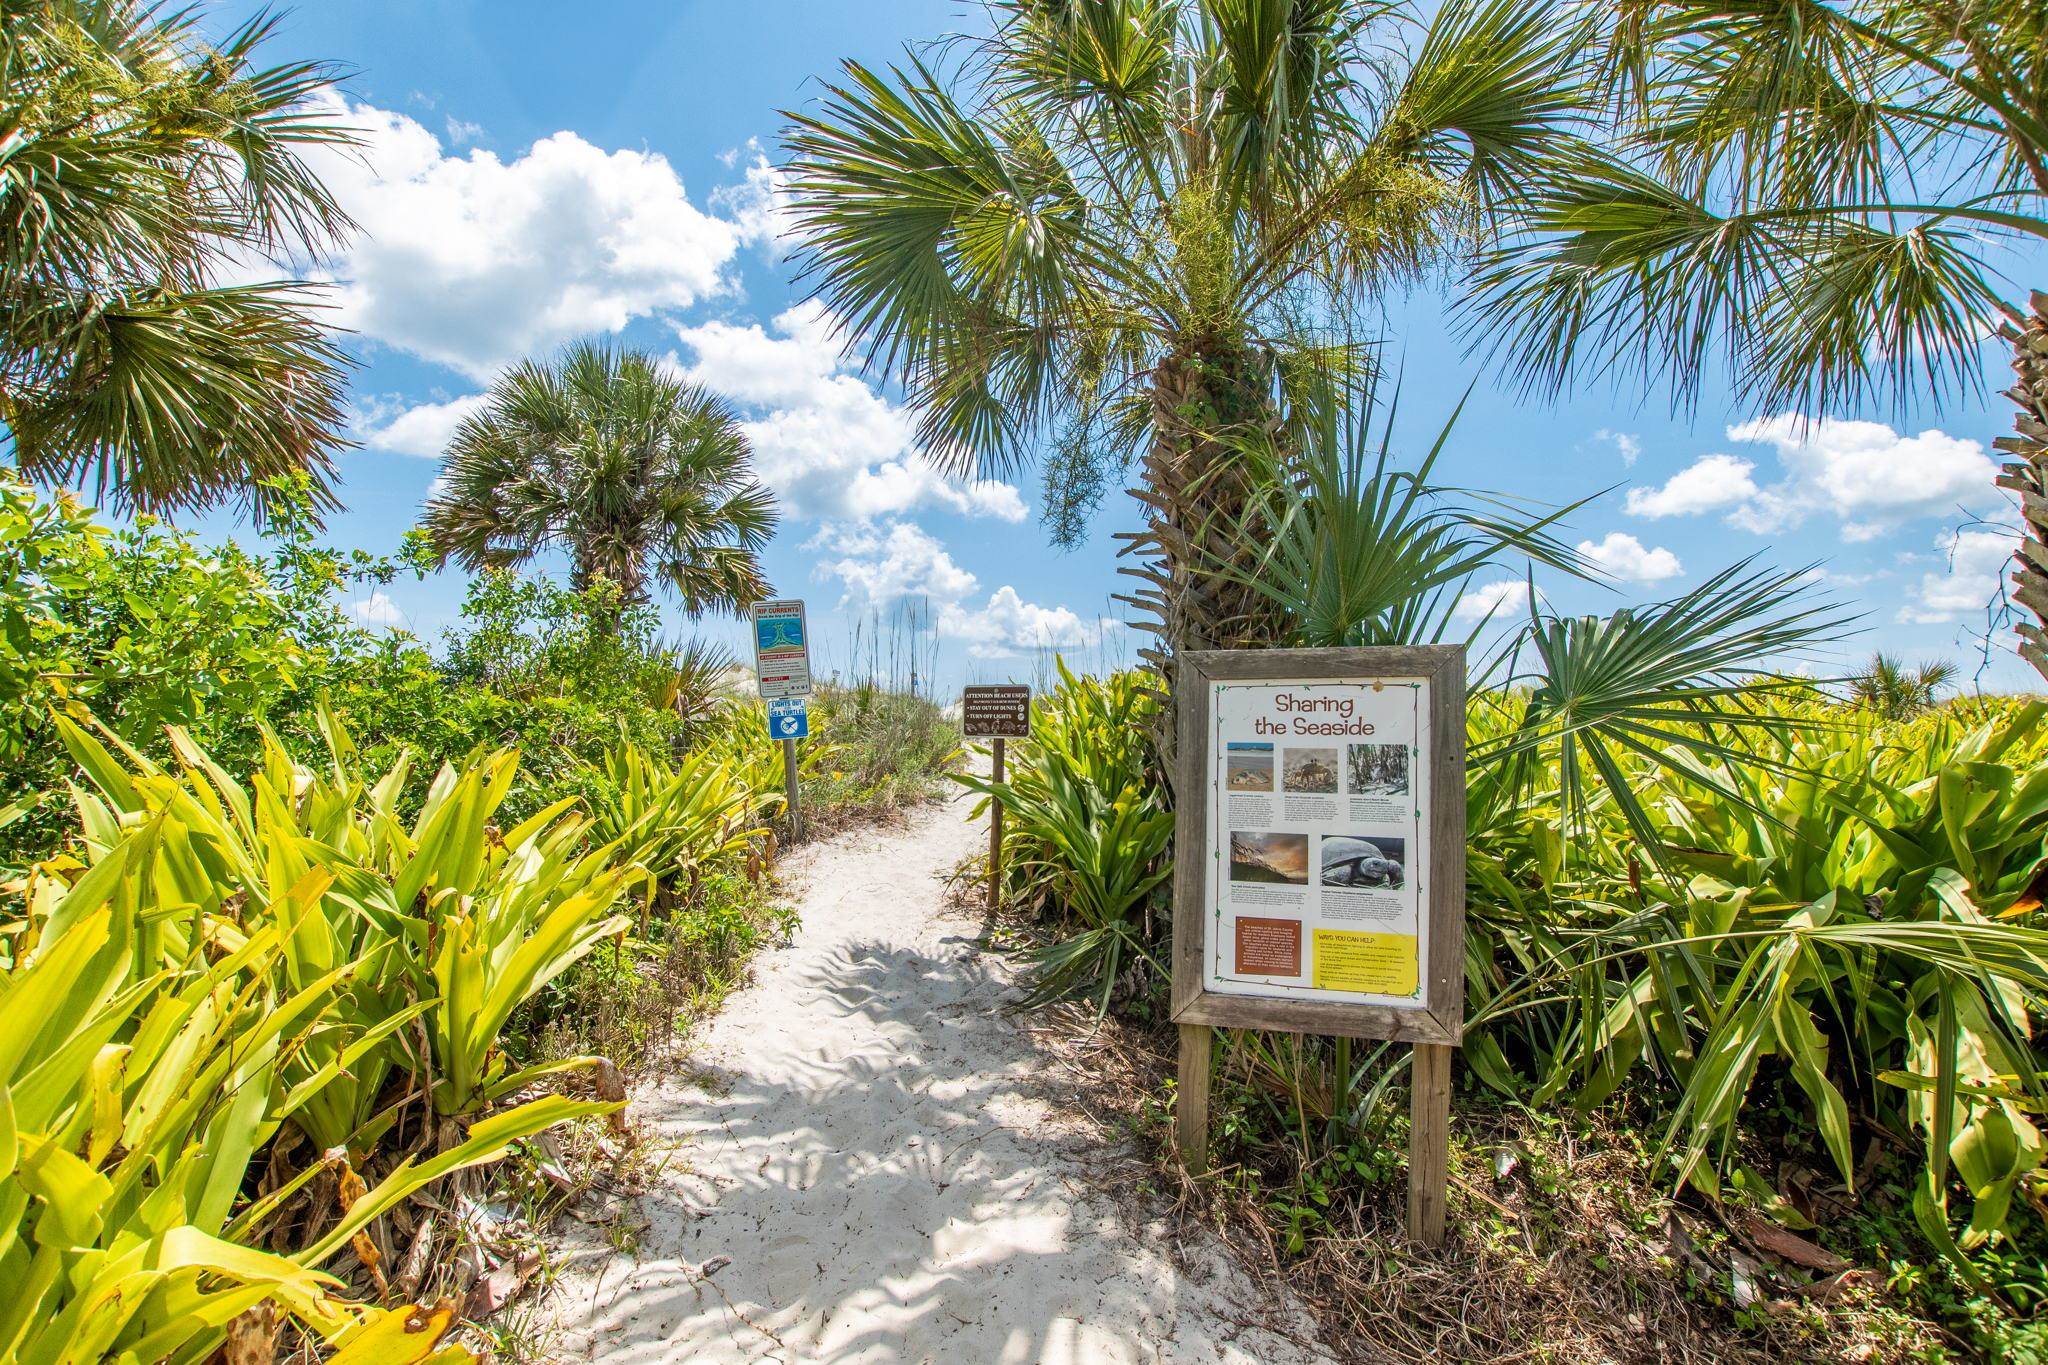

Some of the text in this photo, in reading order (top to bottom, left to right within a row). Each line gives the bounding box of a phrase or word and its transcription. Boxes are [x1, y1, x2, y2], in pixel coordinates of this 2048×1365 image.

[1275, 693, 1354, 718] Sharing
[1255, 716, 1375, 736] the Seaside
